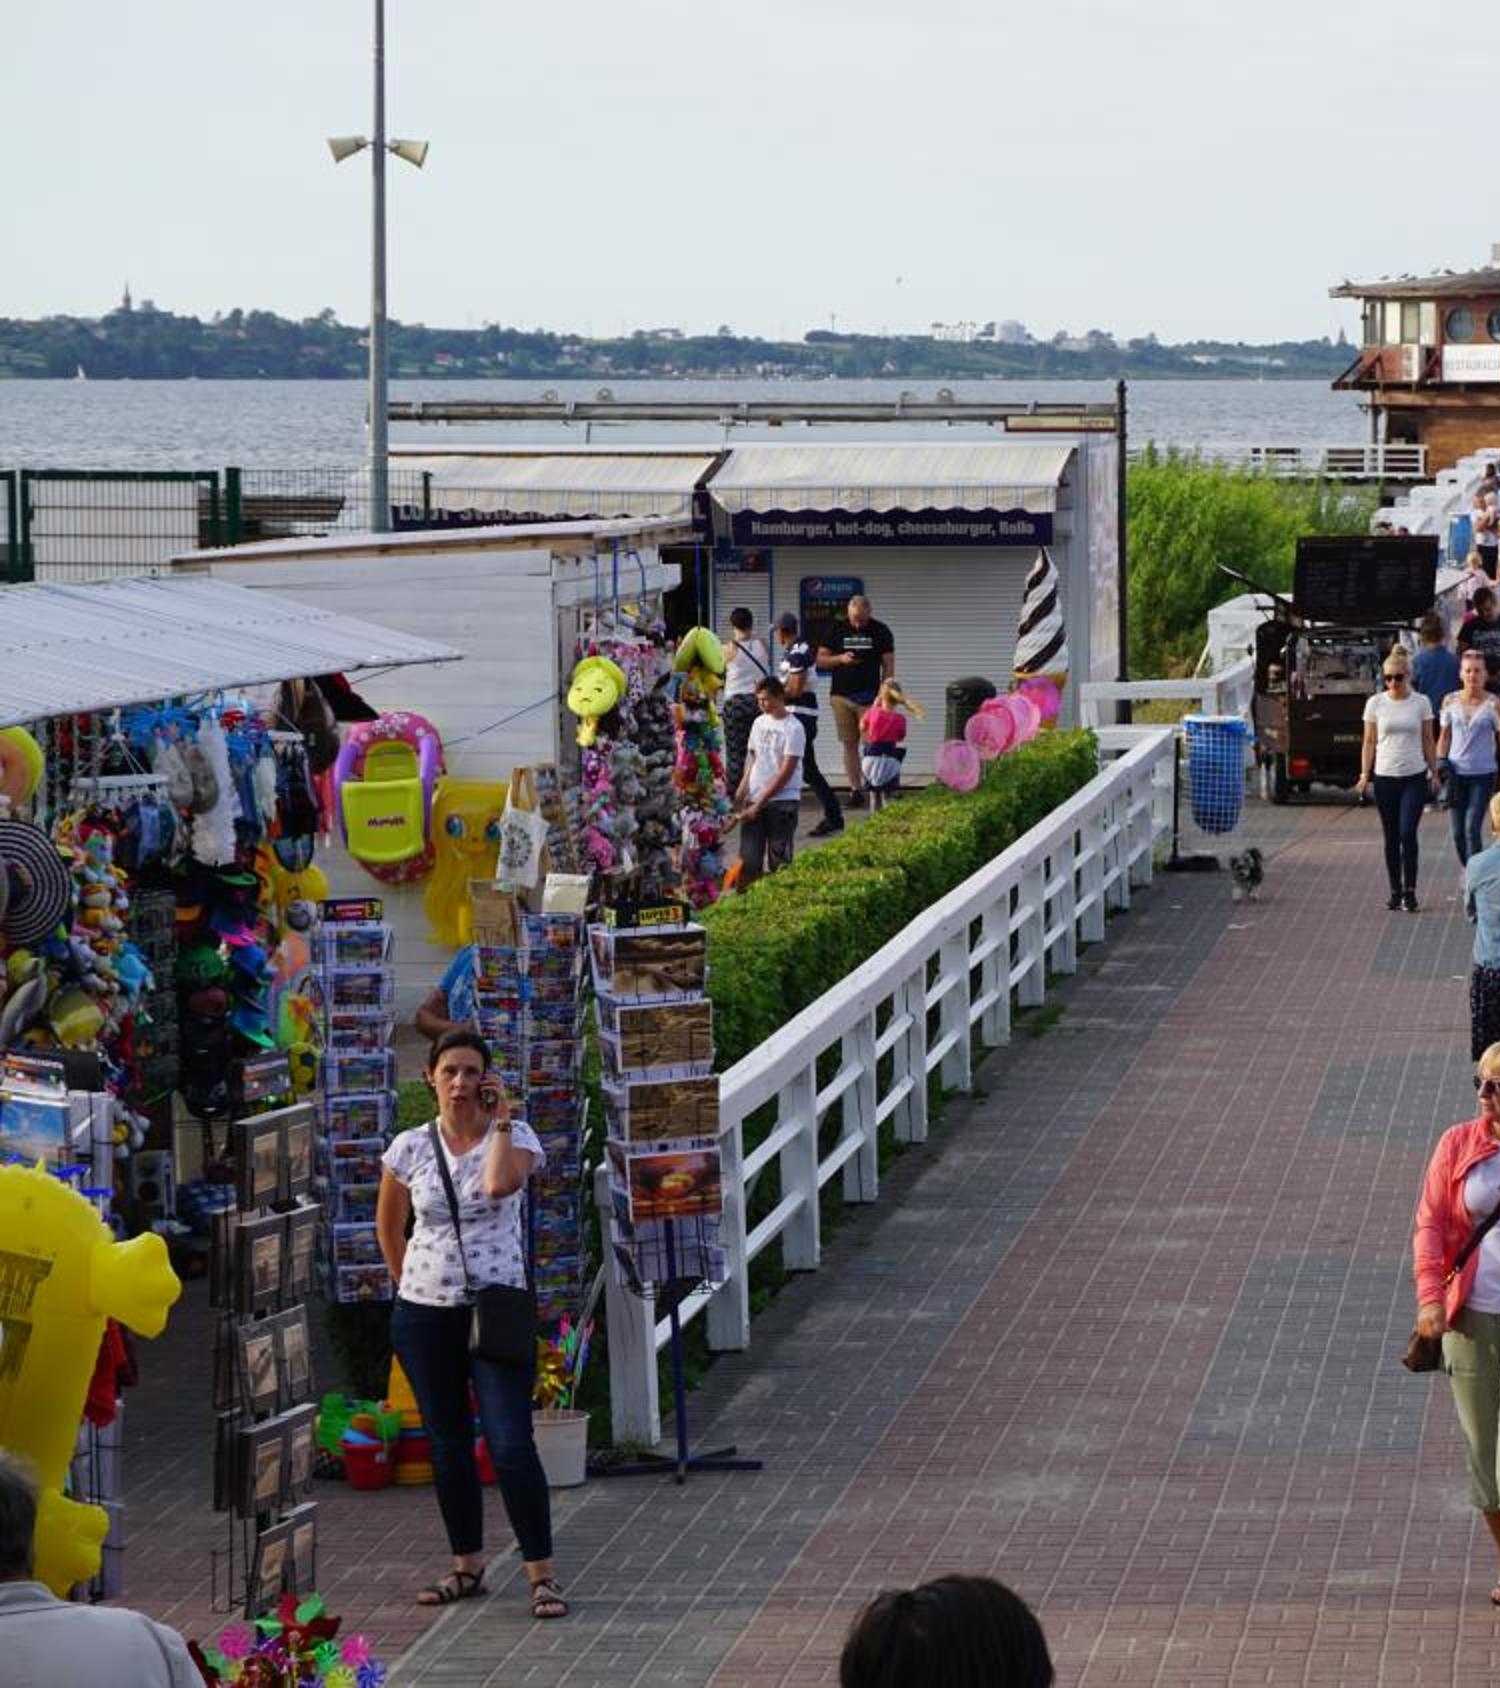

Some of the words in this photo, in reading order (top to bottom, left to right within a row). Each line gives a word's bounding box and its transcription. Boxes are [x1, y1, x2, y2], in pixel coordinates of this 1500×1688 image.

[751, 521, 831, 536] Hamburger,
[835, 521, 894, 537] hot-dog,
[899, 520, 996, 536] cheeseburger,
